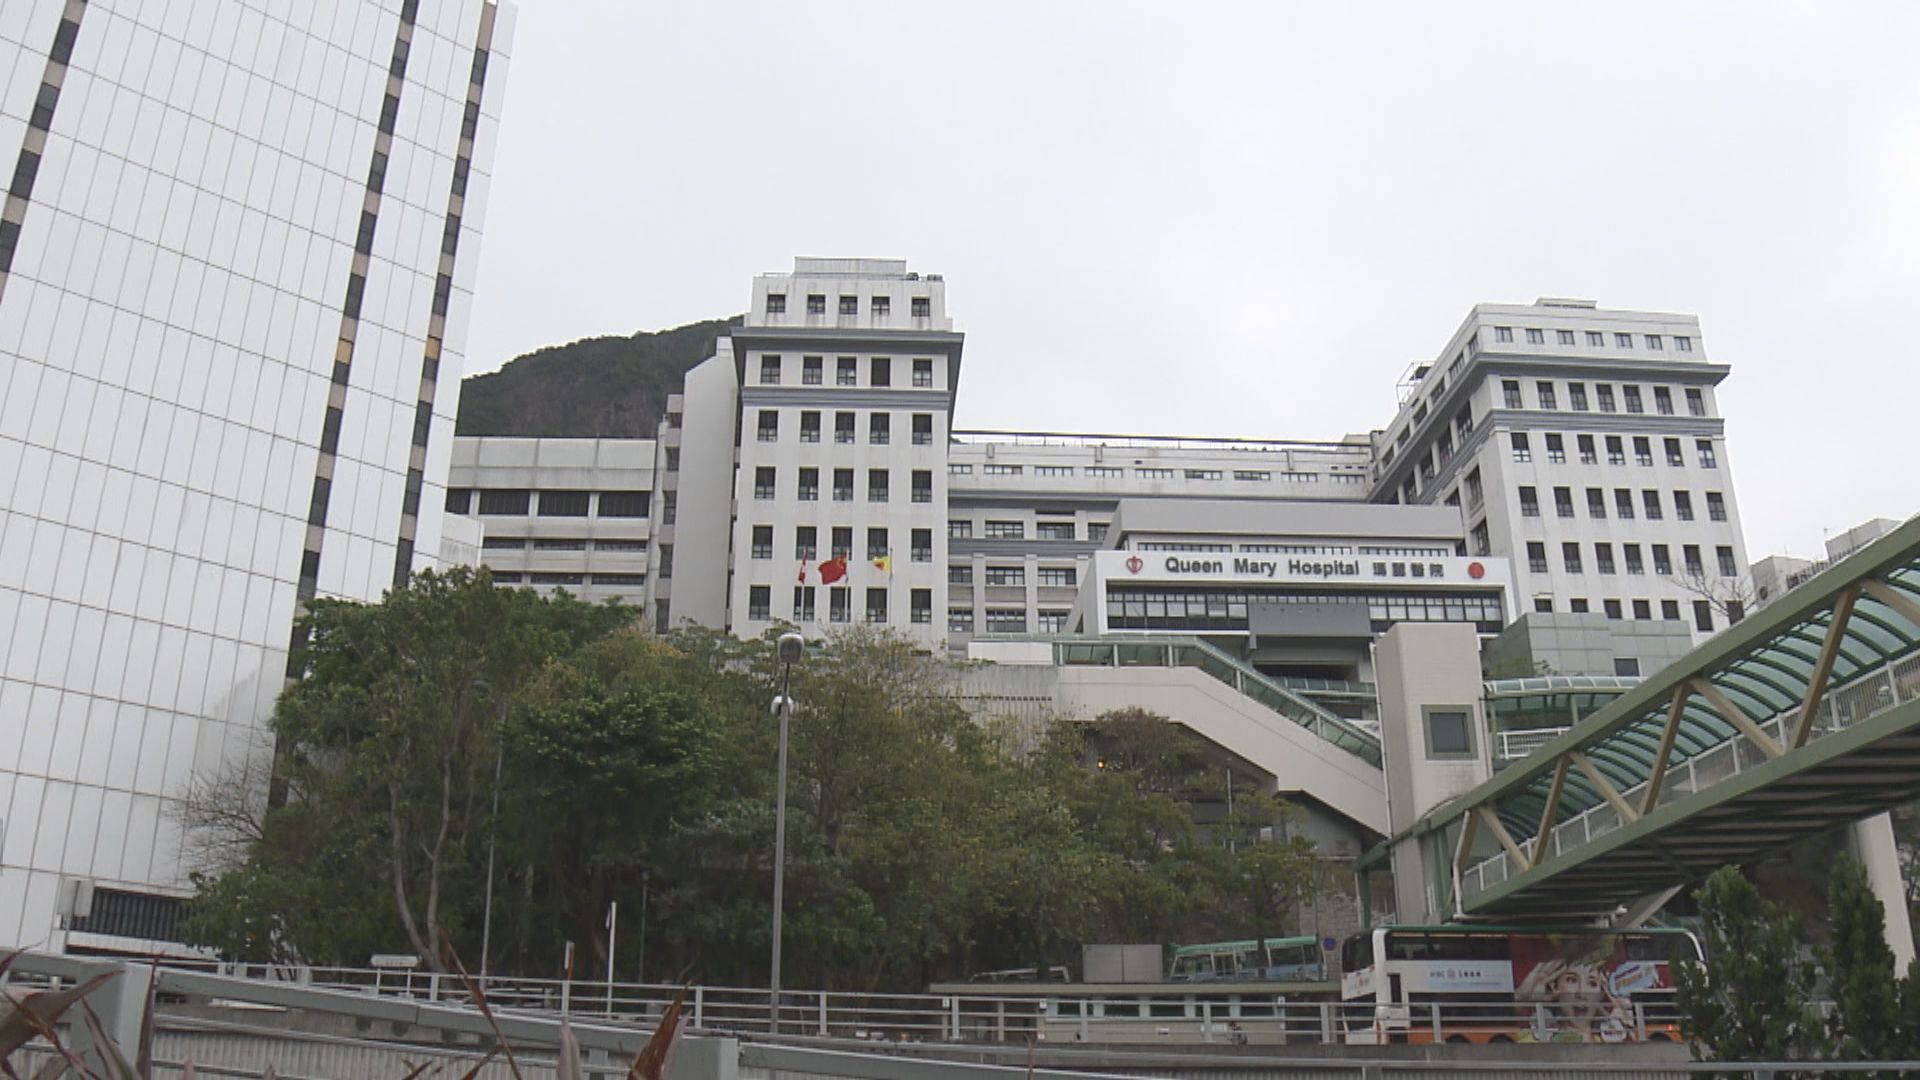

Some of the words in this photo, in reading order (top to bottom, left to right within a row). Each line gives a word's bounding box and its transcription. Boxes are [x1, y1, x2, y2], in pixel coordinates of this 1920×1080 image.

[1165, 556, 1223, 573] Queen
[1234, 558, 1277, 577] Mary
[1289, 560, 1360, 578] Hospital
